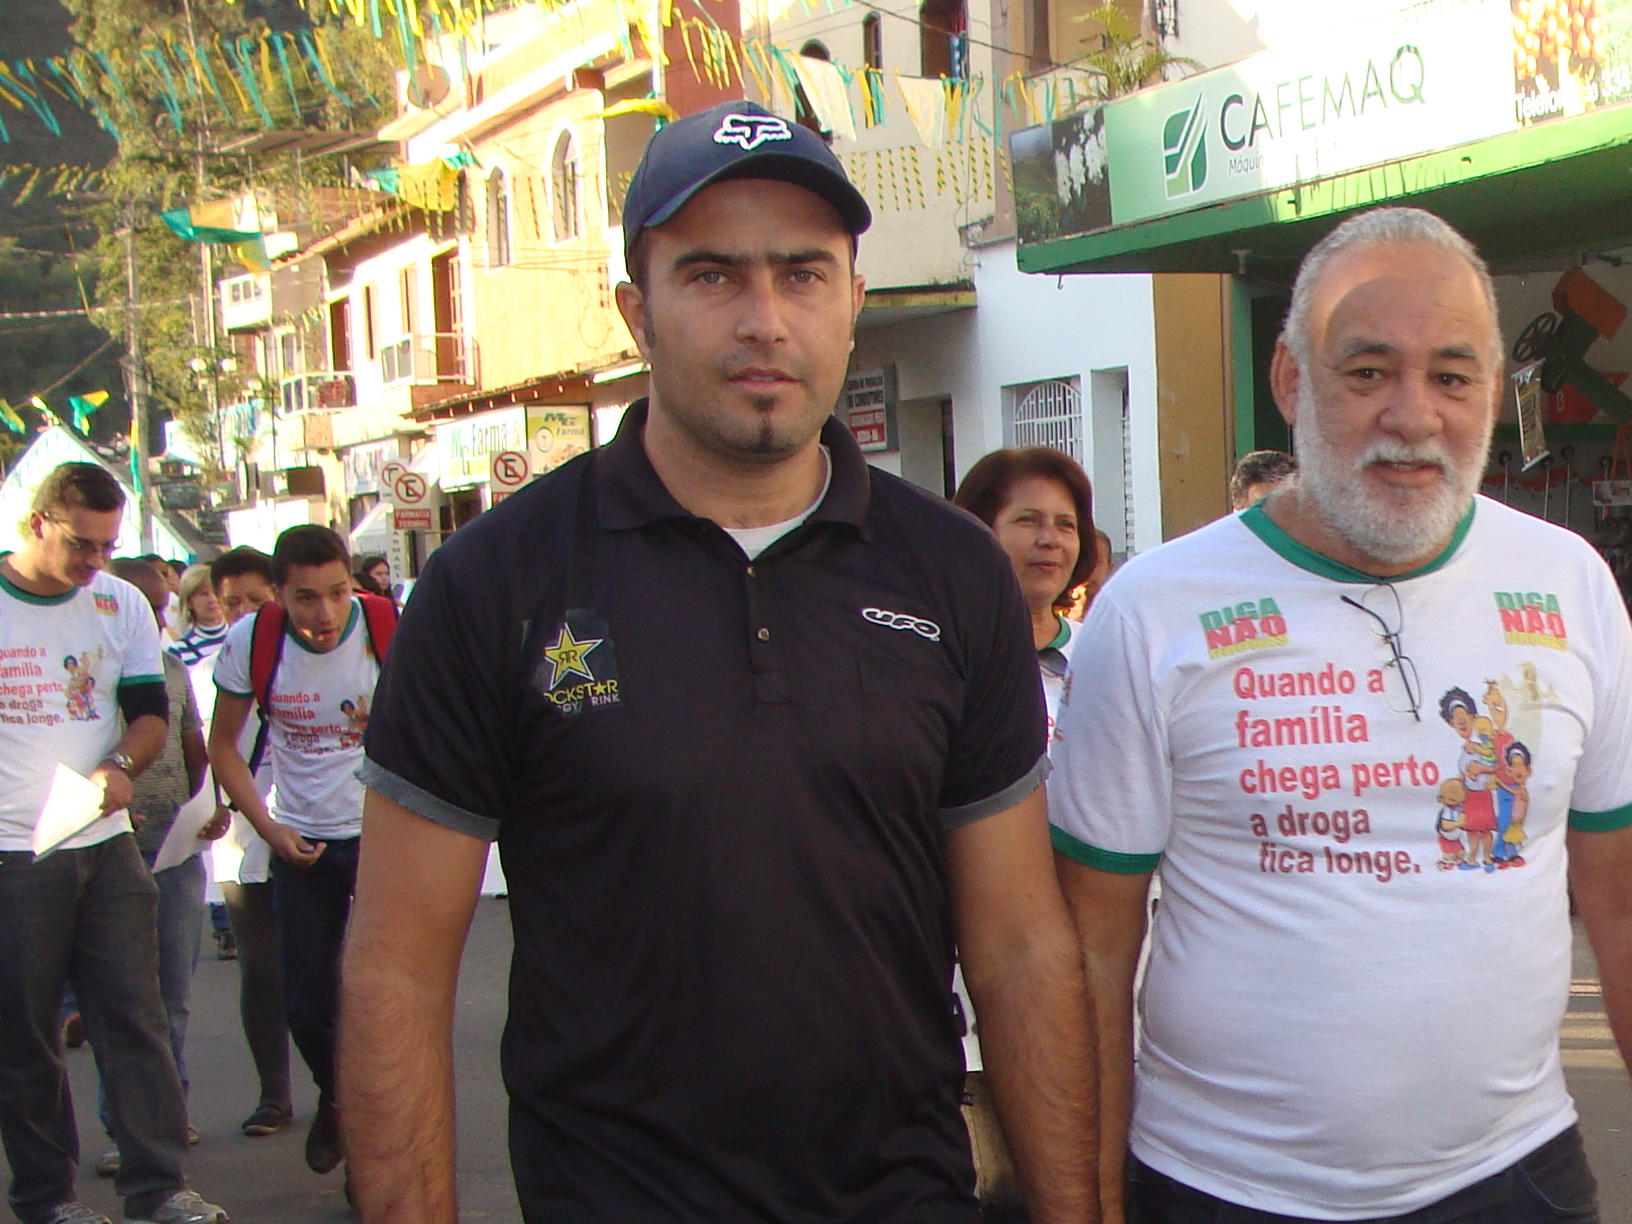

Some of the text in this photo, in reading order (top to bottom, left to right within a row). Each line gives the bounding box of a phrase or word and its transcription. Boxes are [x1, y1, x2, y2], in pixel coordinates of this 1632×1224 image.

[1220, 44, 1426, 151] CAFEMAQ
[1199, 597, 1282, 631] DIGA
[1492, 591, 1561, 614] DIGA
[1205, 615, 1287, 650] NÃO
[1499, 604, 1567, 639] NÃO
[37, 682, 64, 696] perto
[1234, 663, 1385, 700] Quando a
[9, 700, 44, 712] droga
[591, 693, 620, 707] RINK
[27, 713, 64, 726] longe.
[1236, 705, 1370, 748] família
[1239, 754, 1440, 800] chega perto
[1250, 804, 1371, 844] a droga
[1259, 841, 1422, 883] fica longe.
